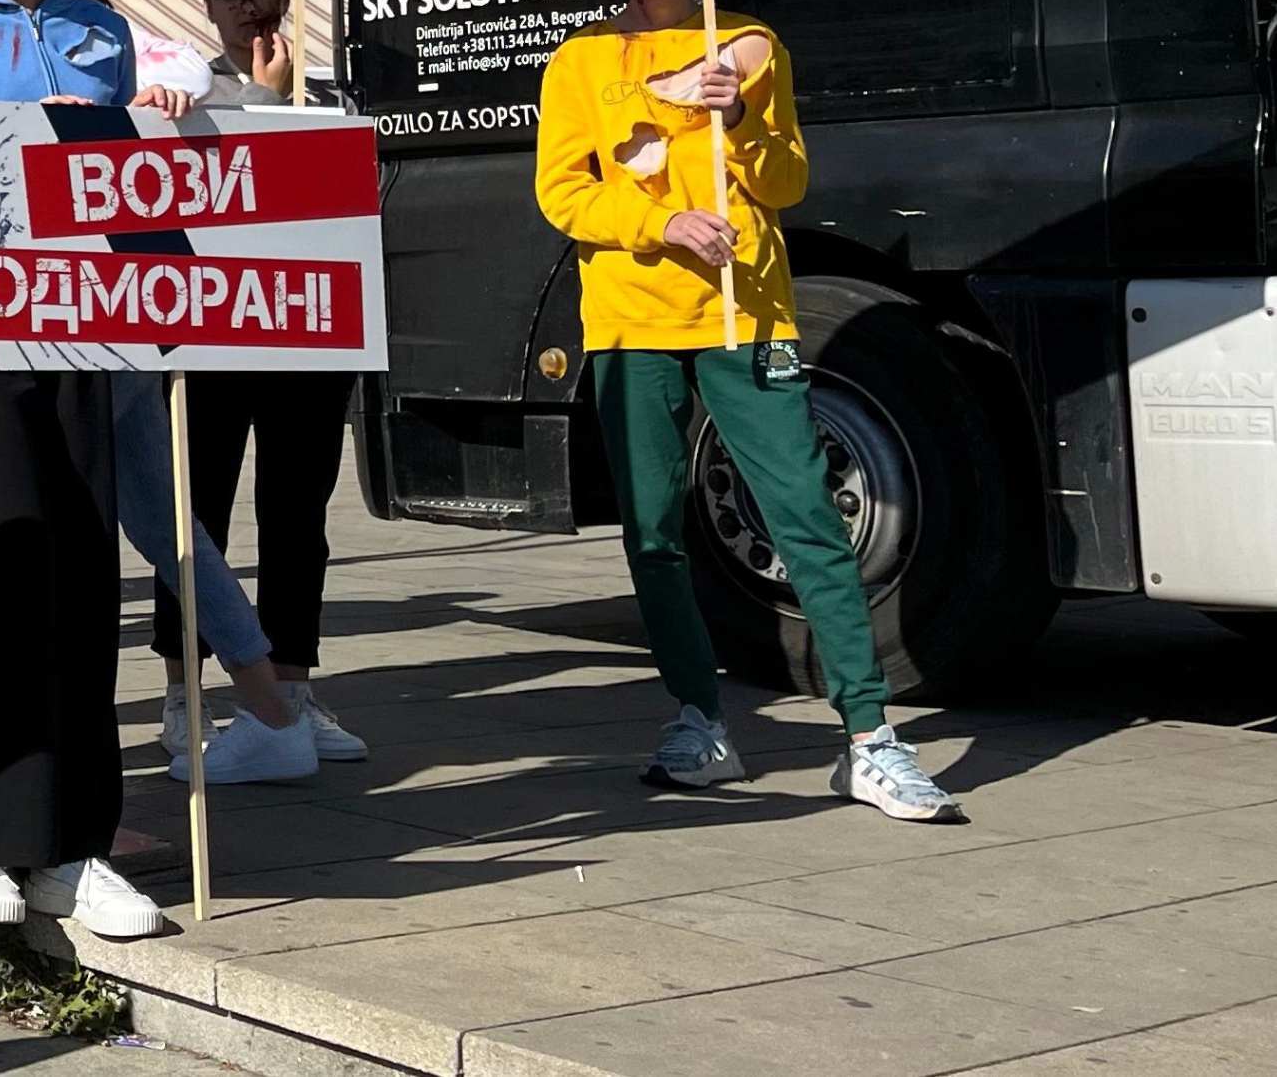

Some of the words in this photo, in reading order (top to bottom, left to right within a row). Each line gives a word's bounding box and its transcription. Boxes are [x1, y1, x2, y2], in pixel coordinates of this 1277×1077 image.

[416, 23, 464, 44] Dimitrija
[417, 42, 460, 58] Telefon:
[429, 59, 455, 74] mail:
[457, 54, 510, 72] info@sky
[437, 110, 464, 132] ZA
[67, 145, 257, 223] ВОЗИ
[1139, 372, 1276, 399] MAN
